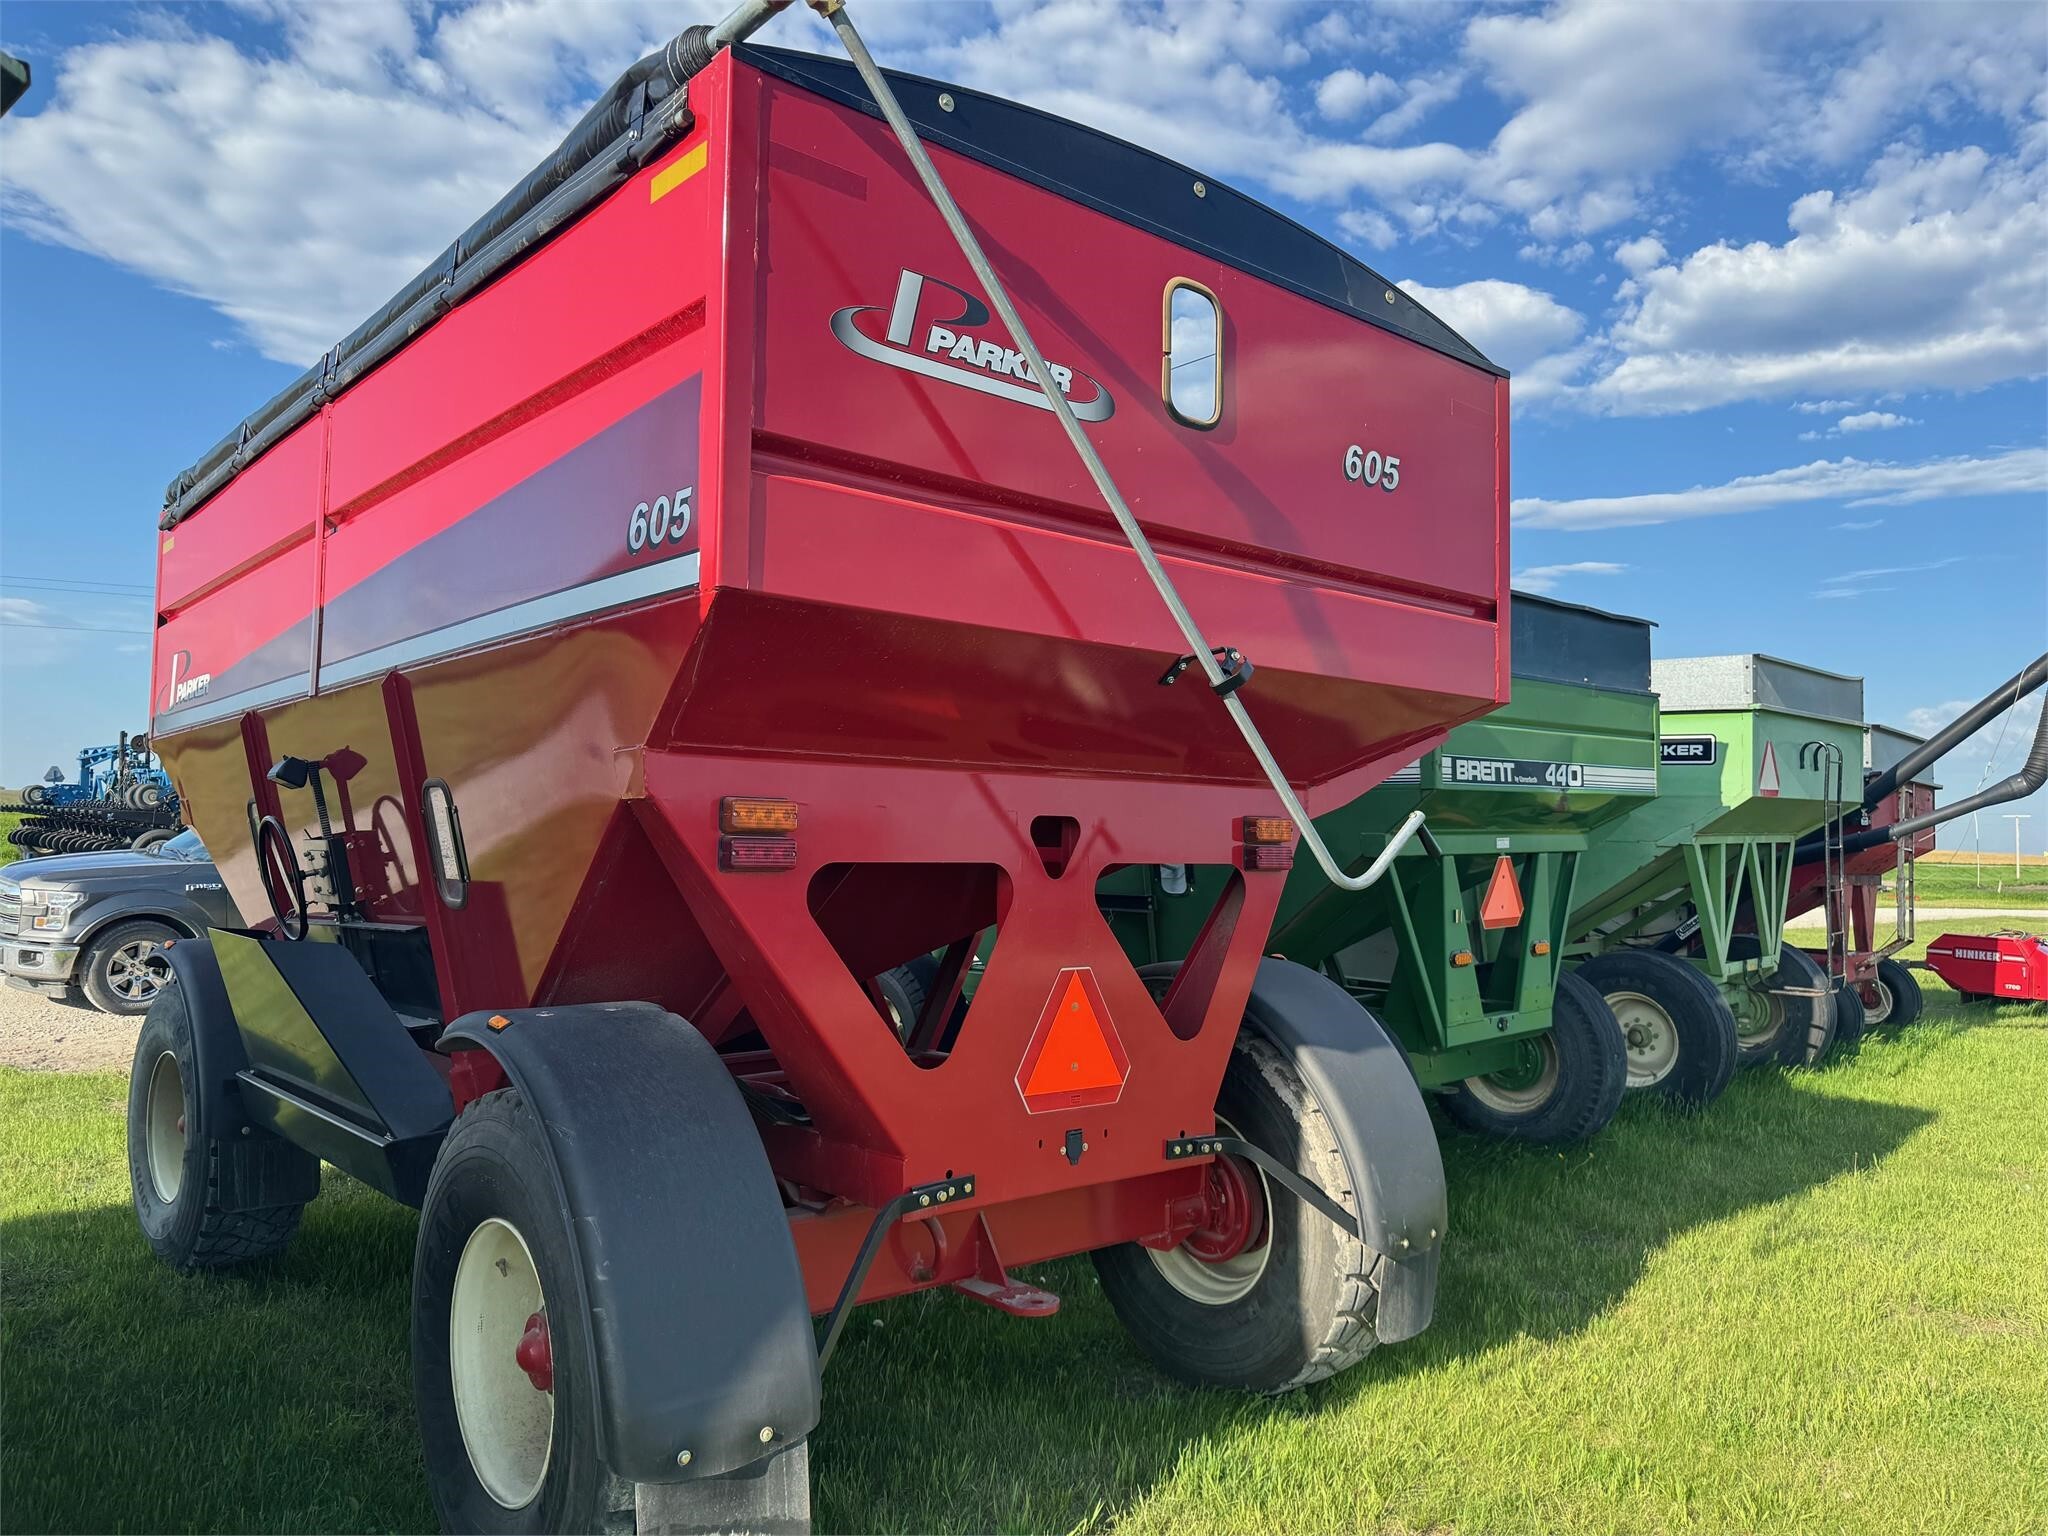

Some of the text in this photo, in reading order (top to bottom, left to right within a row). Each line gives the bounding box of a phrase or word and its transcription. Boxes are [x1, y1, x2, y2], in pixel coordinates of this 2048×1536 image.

[1343, 444, 1401, 492] 605
[627, 485, 693, 555] 605
[176, 673, 211, 704] PARKER
[1660, 744, 1704, 756] KER
[1455, 759, 1515, 783] BRENT
[1545, 763, 1583, 787] 440
[1955, 948, 2001, 962] HINIKER
